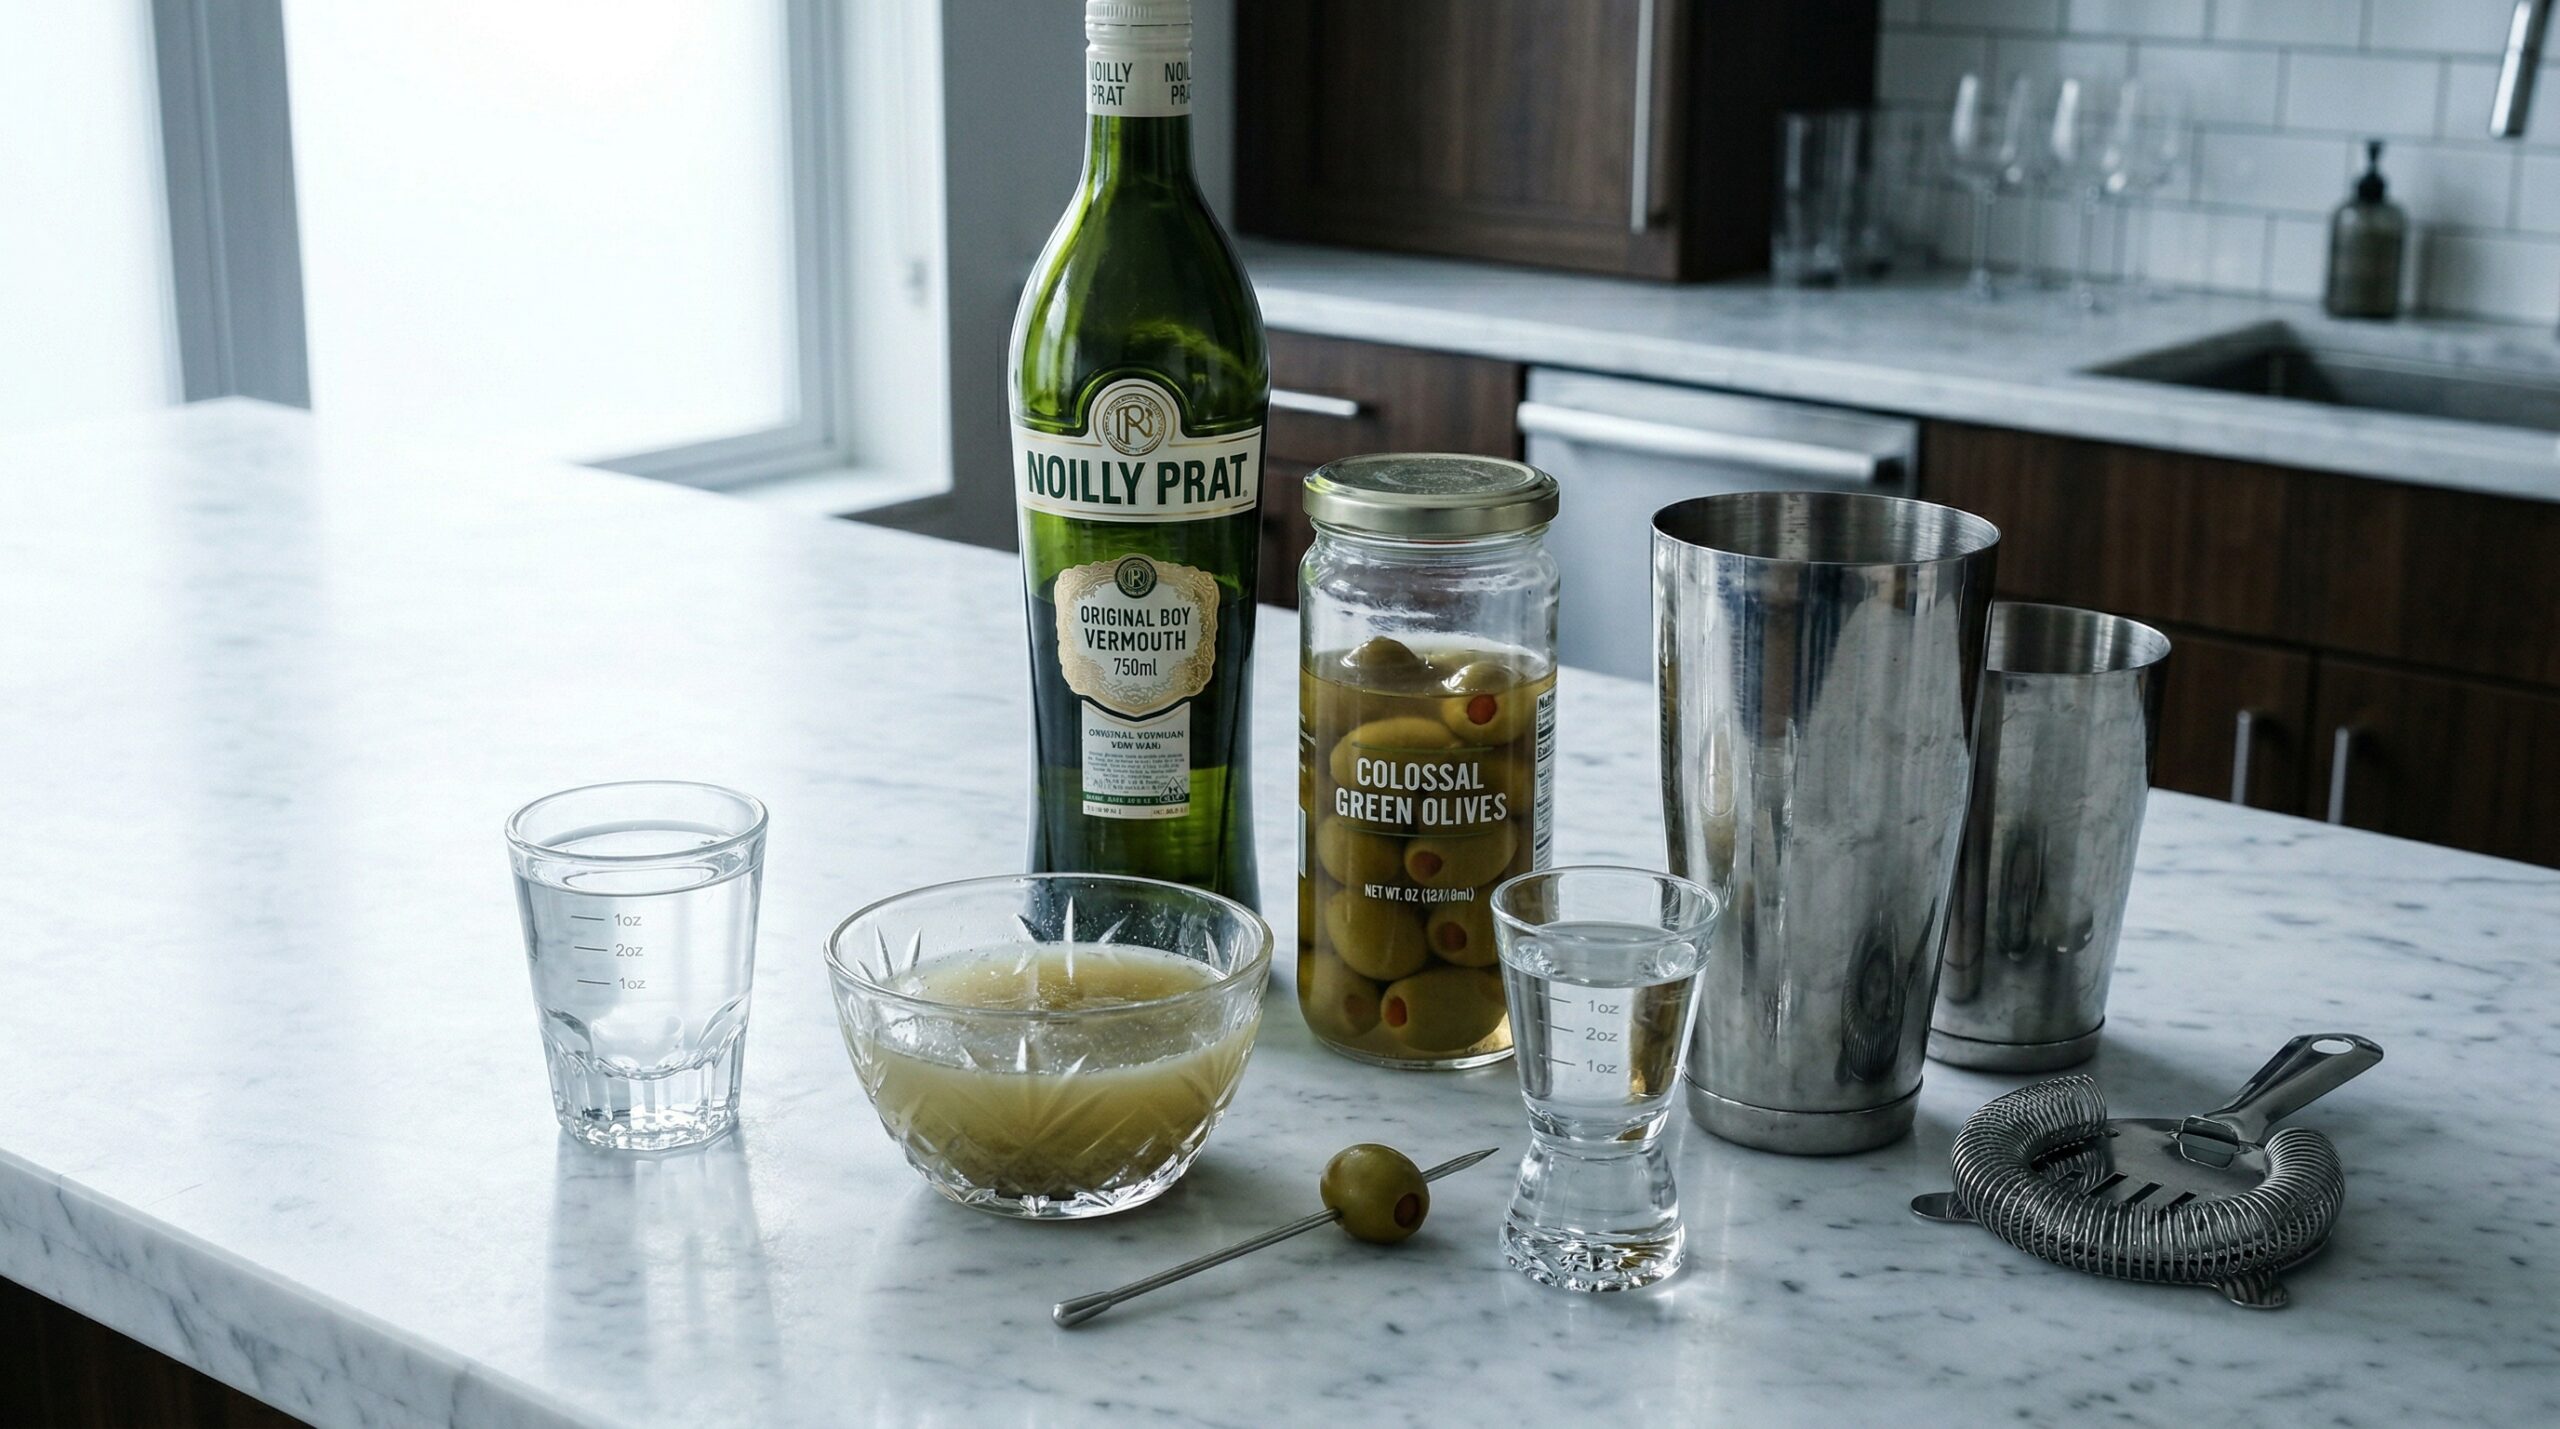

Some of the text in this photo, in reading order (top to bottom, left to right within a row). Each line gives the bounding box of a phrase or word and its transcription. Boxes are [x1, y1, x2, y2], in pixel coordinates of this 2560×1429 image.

[1027, 450, 1146, 505] NOILLY
[1081, 605, 1191, 628] ORIGINAL BOY
[1084, 628, 1186, 652] VERMOUTH
[1113, 658, 1158, 677] 750ml
[1356, 757, 1484, 792] COLOSSAL
[1335, 787, 1507, 827] GREEN OLIVES
[1364, 883, 1383, 899] NET
[1385, 886, 1403, 901] WT.
[1404, 888, 1419, 902] OZ
[614, 913, 642, 927] 1oz
[615, 943, 644, 958] 2oz
[618, 977, 646, 990] 1oz
[1587, 1000, 1620, 1015] 1oz
[1585, 1027, 1618, 1042] 2oz
[1586, 1060, 1618, 1074] 1oz
